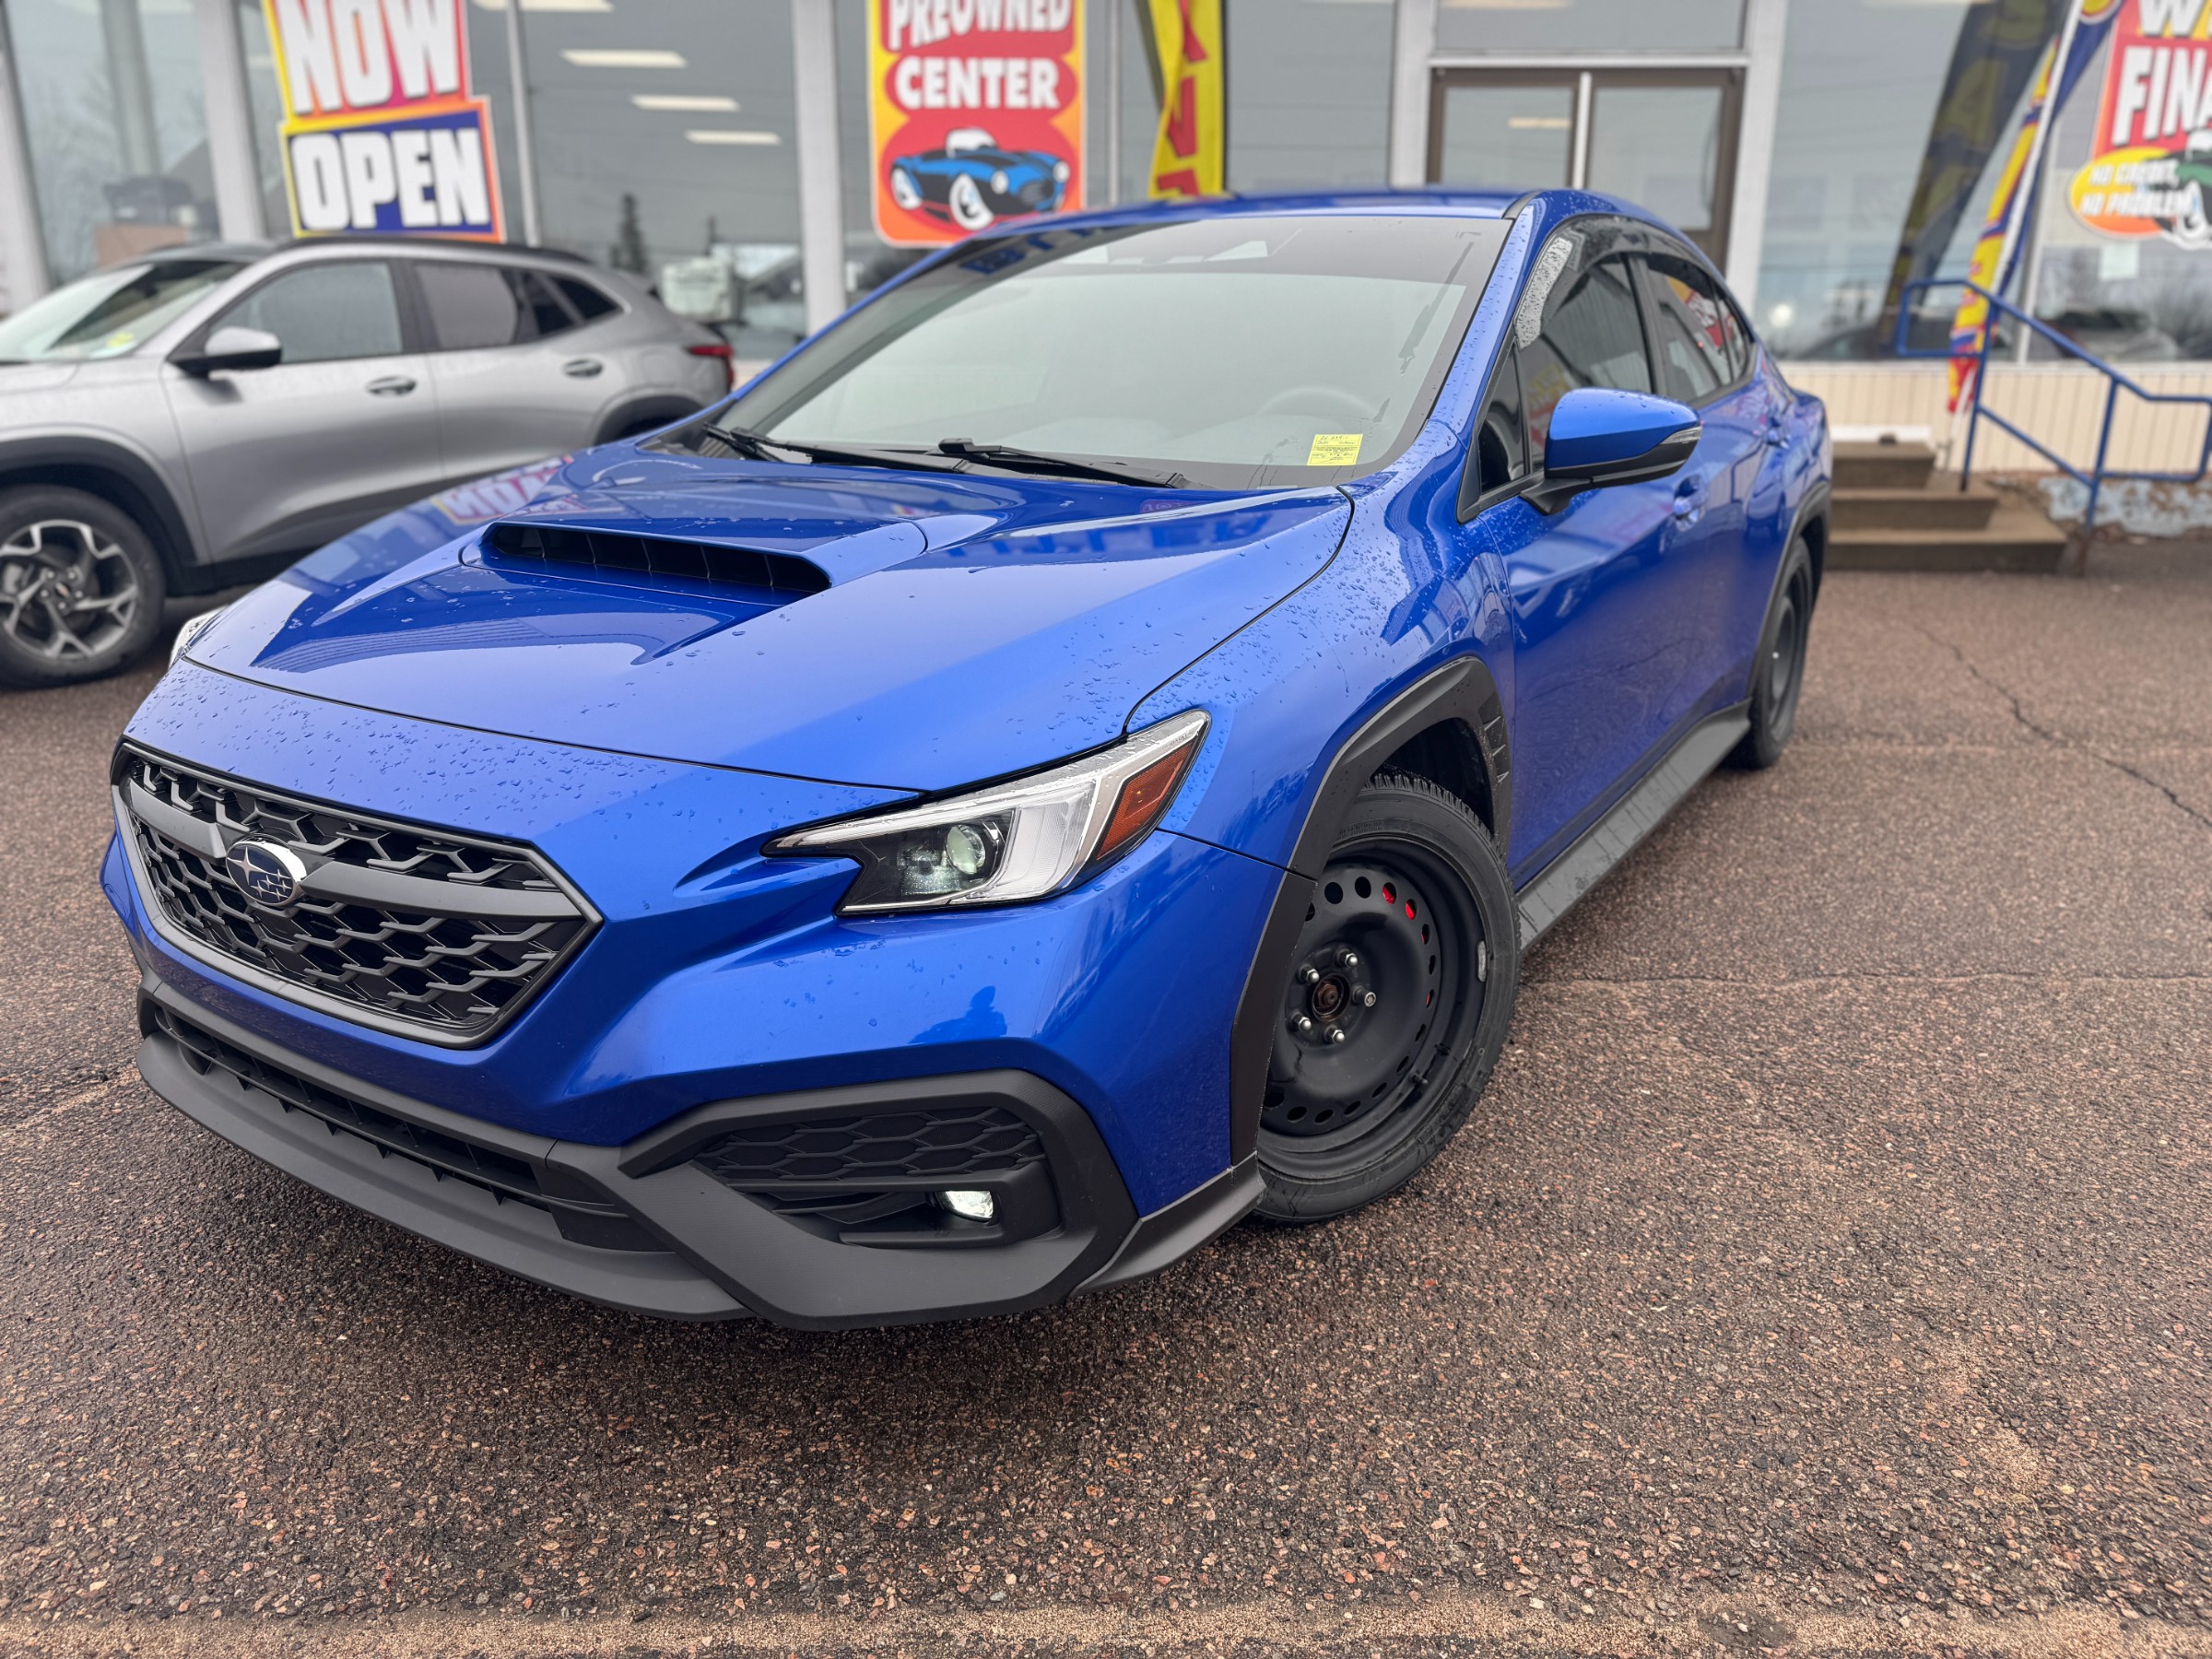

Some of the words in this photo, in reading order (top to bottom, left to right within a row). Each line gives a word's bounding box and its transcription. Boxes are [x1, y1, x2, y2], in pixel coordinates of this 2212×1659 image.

[278, 0, 460, 114] NOW
[888, 0, 1073, 51] PREOWNED
[894, 55, 1061, 110] CENTER
[291, 127, 490, 230] OPEN
